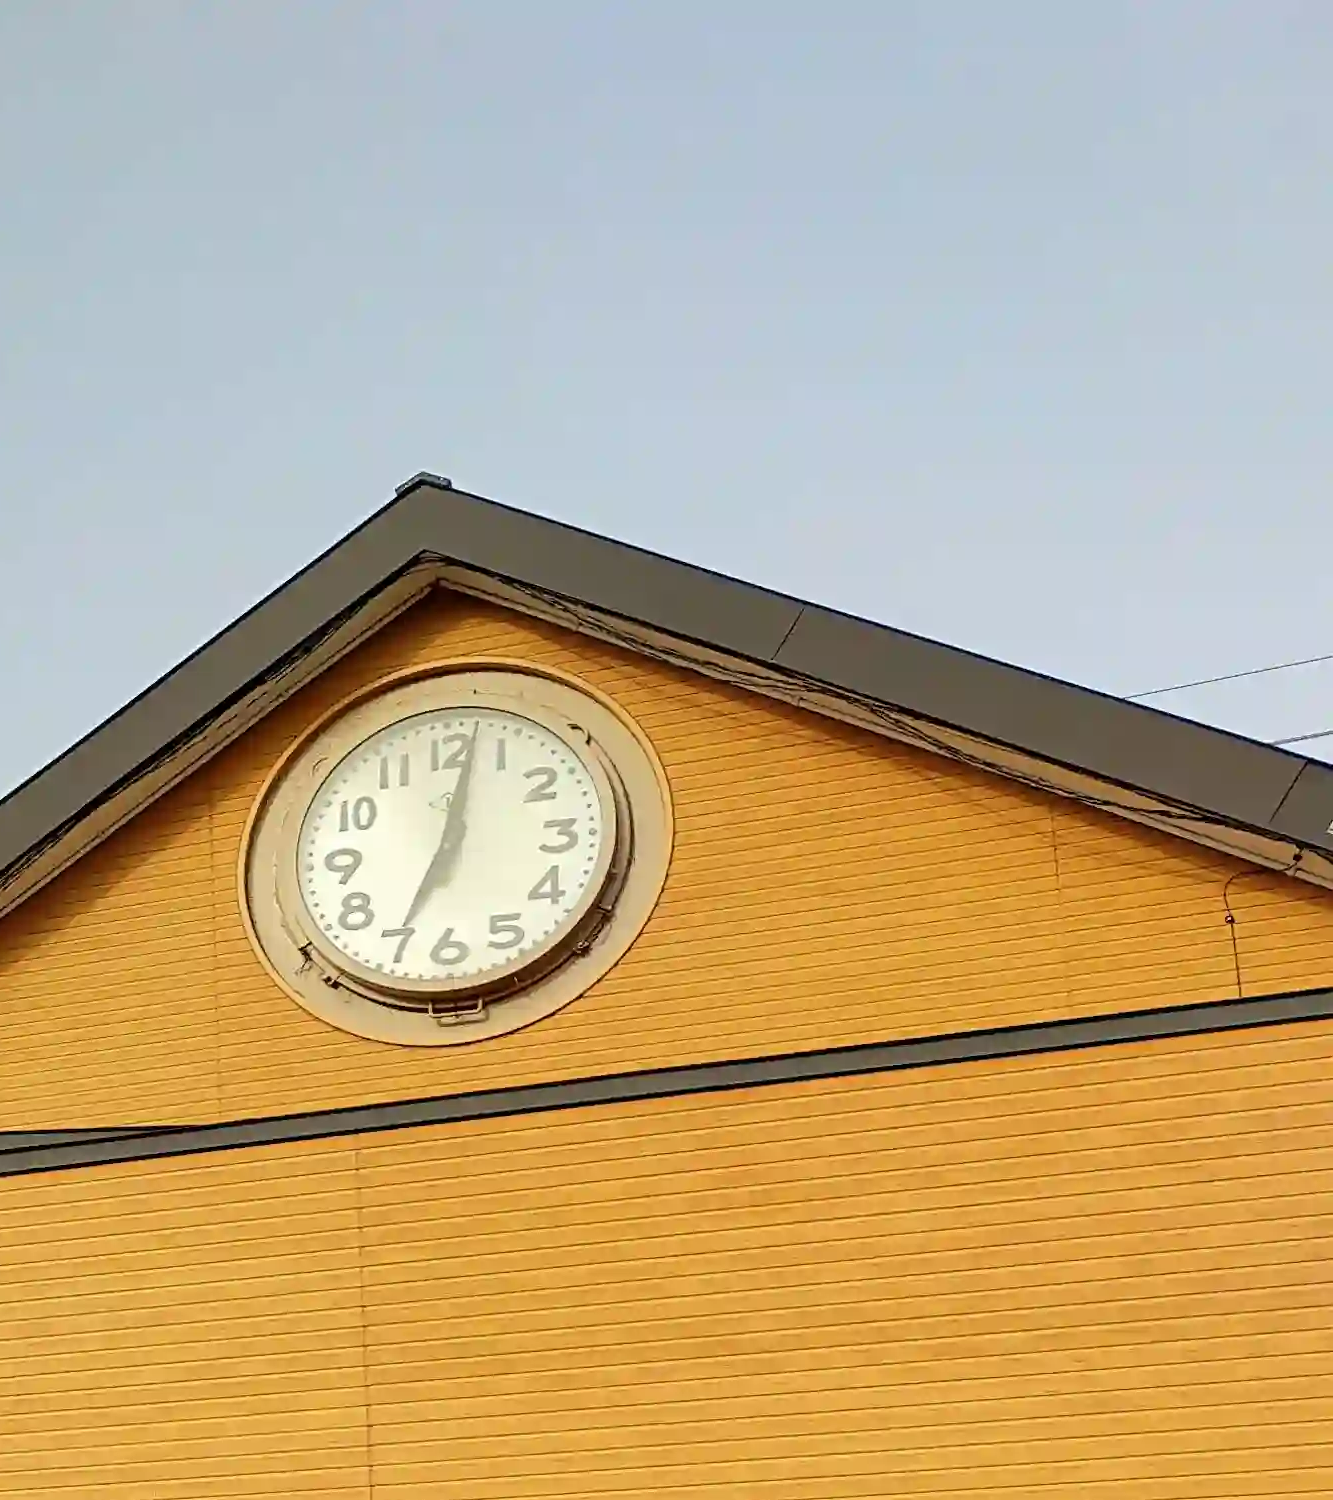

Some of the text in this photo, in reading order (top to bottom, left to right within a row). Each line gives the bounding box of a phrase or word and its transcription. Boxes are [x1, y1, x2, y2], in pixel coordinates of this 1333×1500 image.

[430, 733, 473, 771] 12
[496, 738, 506, 770] 1
[379, 752, 409, 789] 11
[523, 766, 557, 802] 2
[338, 796, 377, 832] 10
[539, 818, 578, 853] 3
[324, 848, 363, 884] 9
[527, 865, 566, 904] 4
[337, 892, 374, 930] 8
[380, 926, 416, 963] 7
[429, 927, 470, 966] 6
[487, 913, 525, 949] 5
